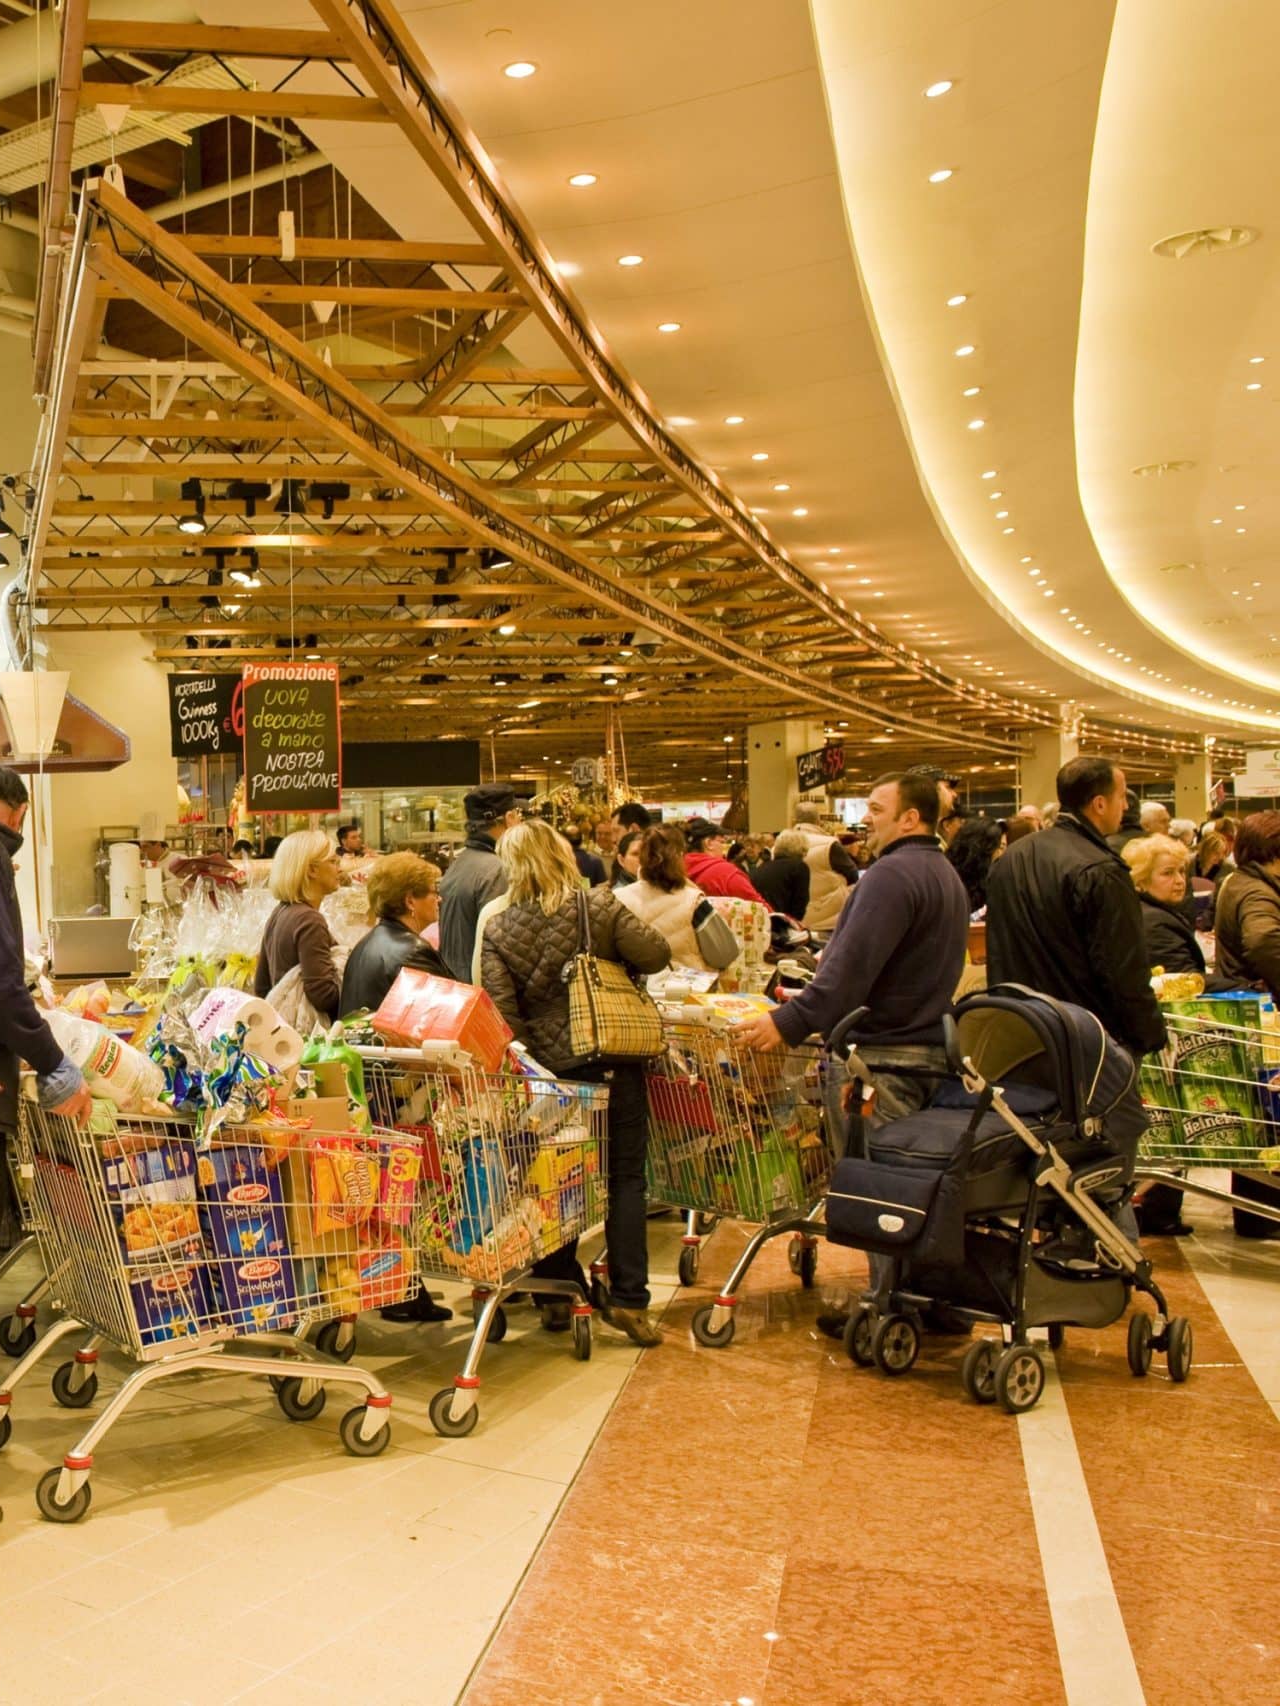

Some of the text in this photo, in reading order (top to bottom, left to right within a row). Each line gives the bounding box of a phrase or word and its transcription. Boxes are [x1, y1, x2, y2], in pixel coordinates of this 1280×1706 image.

[243, 663, 336, 681] Promozione
[264, 687, 310, 707] UOVA
[252, 706, 326, 730] decorate
[261, 731, 325, 749] a mano
[265, 749, 325, 772] NOSTRA
[251, 770, 339, 800] PRODUZIONE
